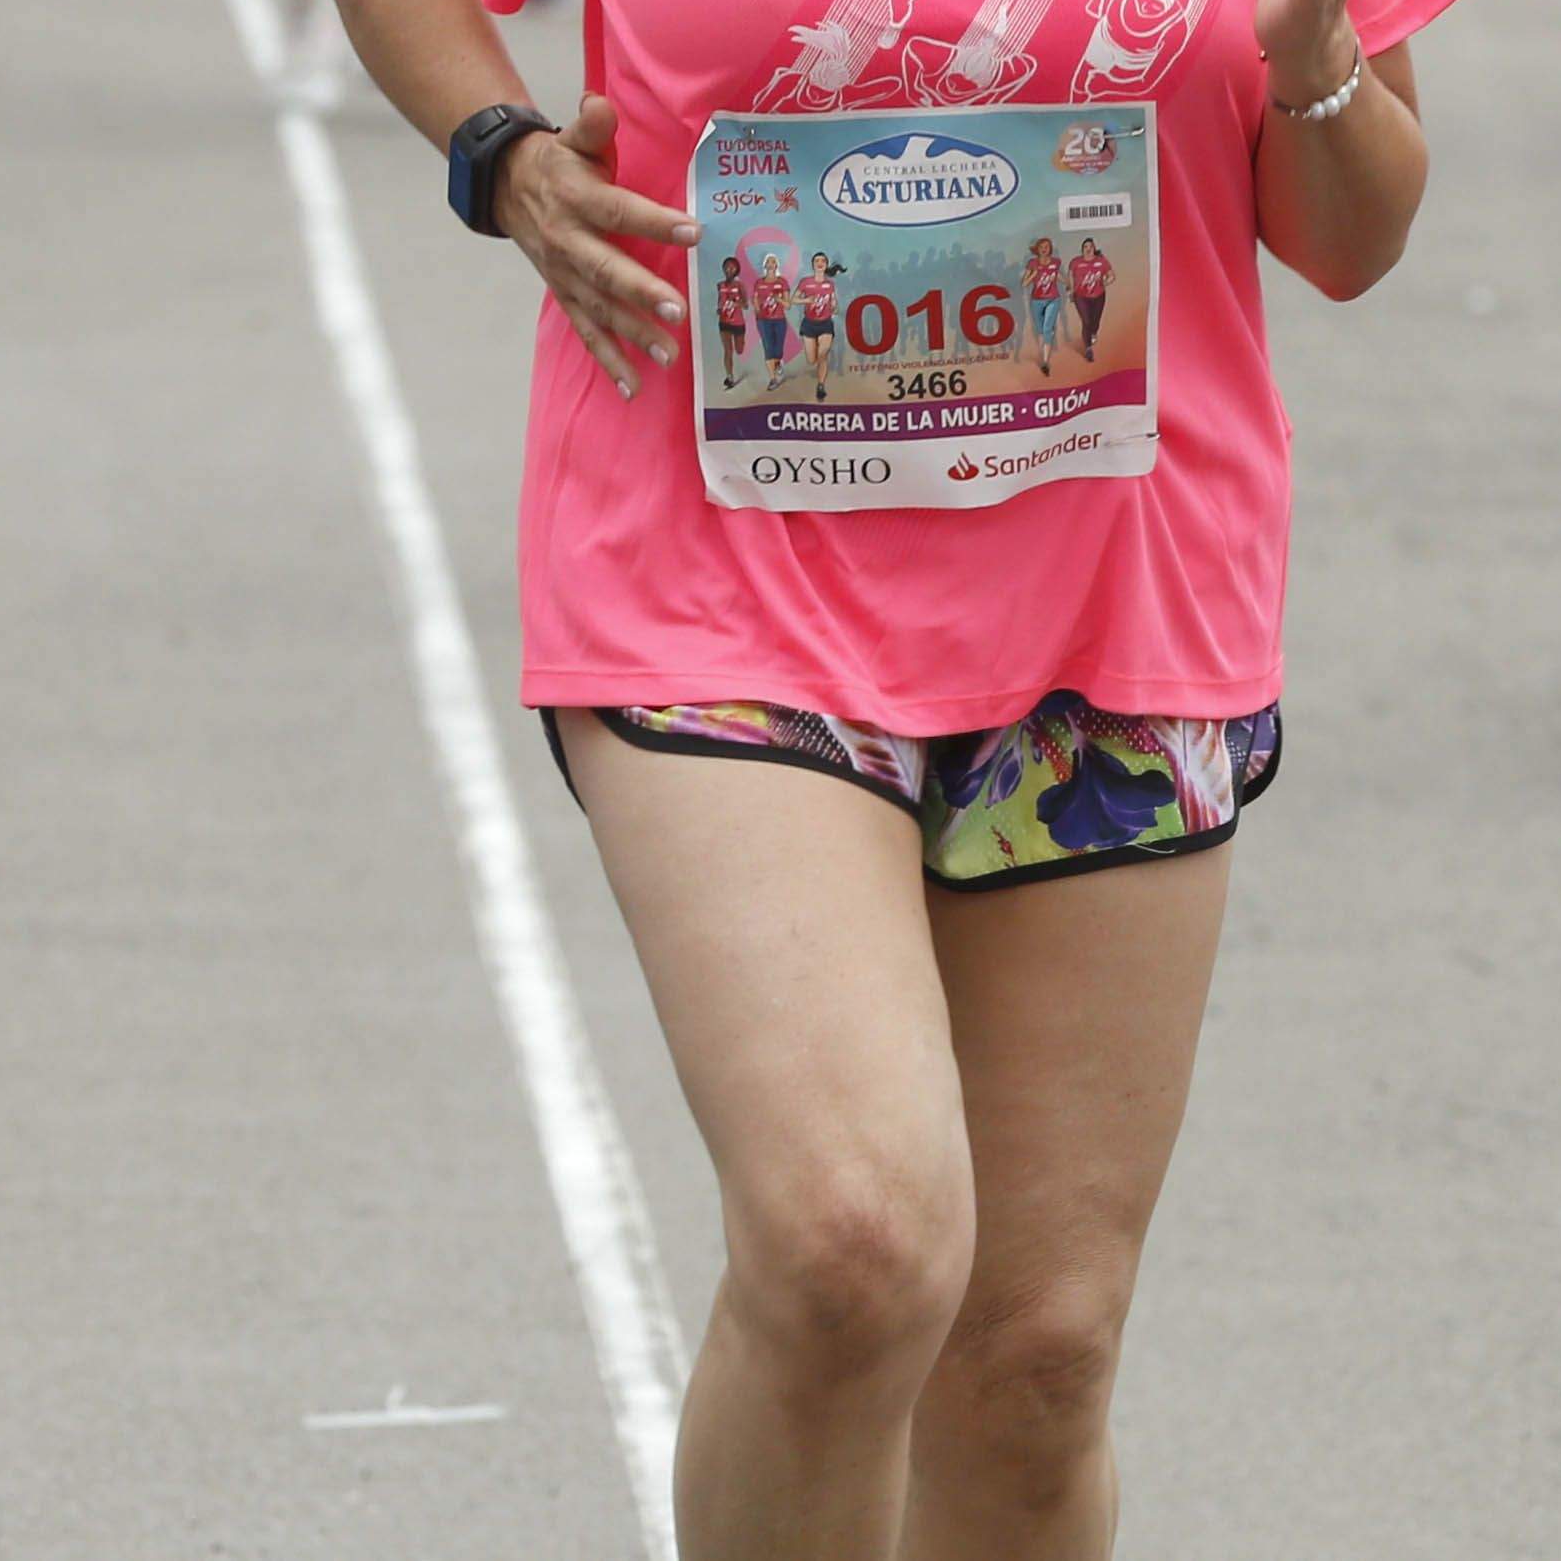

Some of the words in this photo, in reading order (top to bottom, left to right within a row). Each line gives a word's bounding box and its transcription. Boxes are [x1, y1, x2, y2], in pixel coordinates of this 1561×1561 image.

[716, 139, 732, 151] TU
[737, 139, 790, 151] DORSAL
[1065, 127, 1105, 155] 20
[718, 154, 790, 176] SUMA
[864, 165, 925, 176] CENTRAL
[932, 161, 996, 173] LECHERA
[836, 168, 1004, 204] ASTURIANA
[844, 284, 1015, 356] 016
[888, 370, 967, 400] 3466
[767, 411, 865, 432] CARRERA
[872, 411, 900, 431] DE
[907, 410, 934, 431] LA
[941, 403, 1015, 428] MUJER
[1035, 389, 1091, 418] GIJÓN
[751, 455, 891, 484] OYSHO
[984, 432, 1102, 478] Santander
